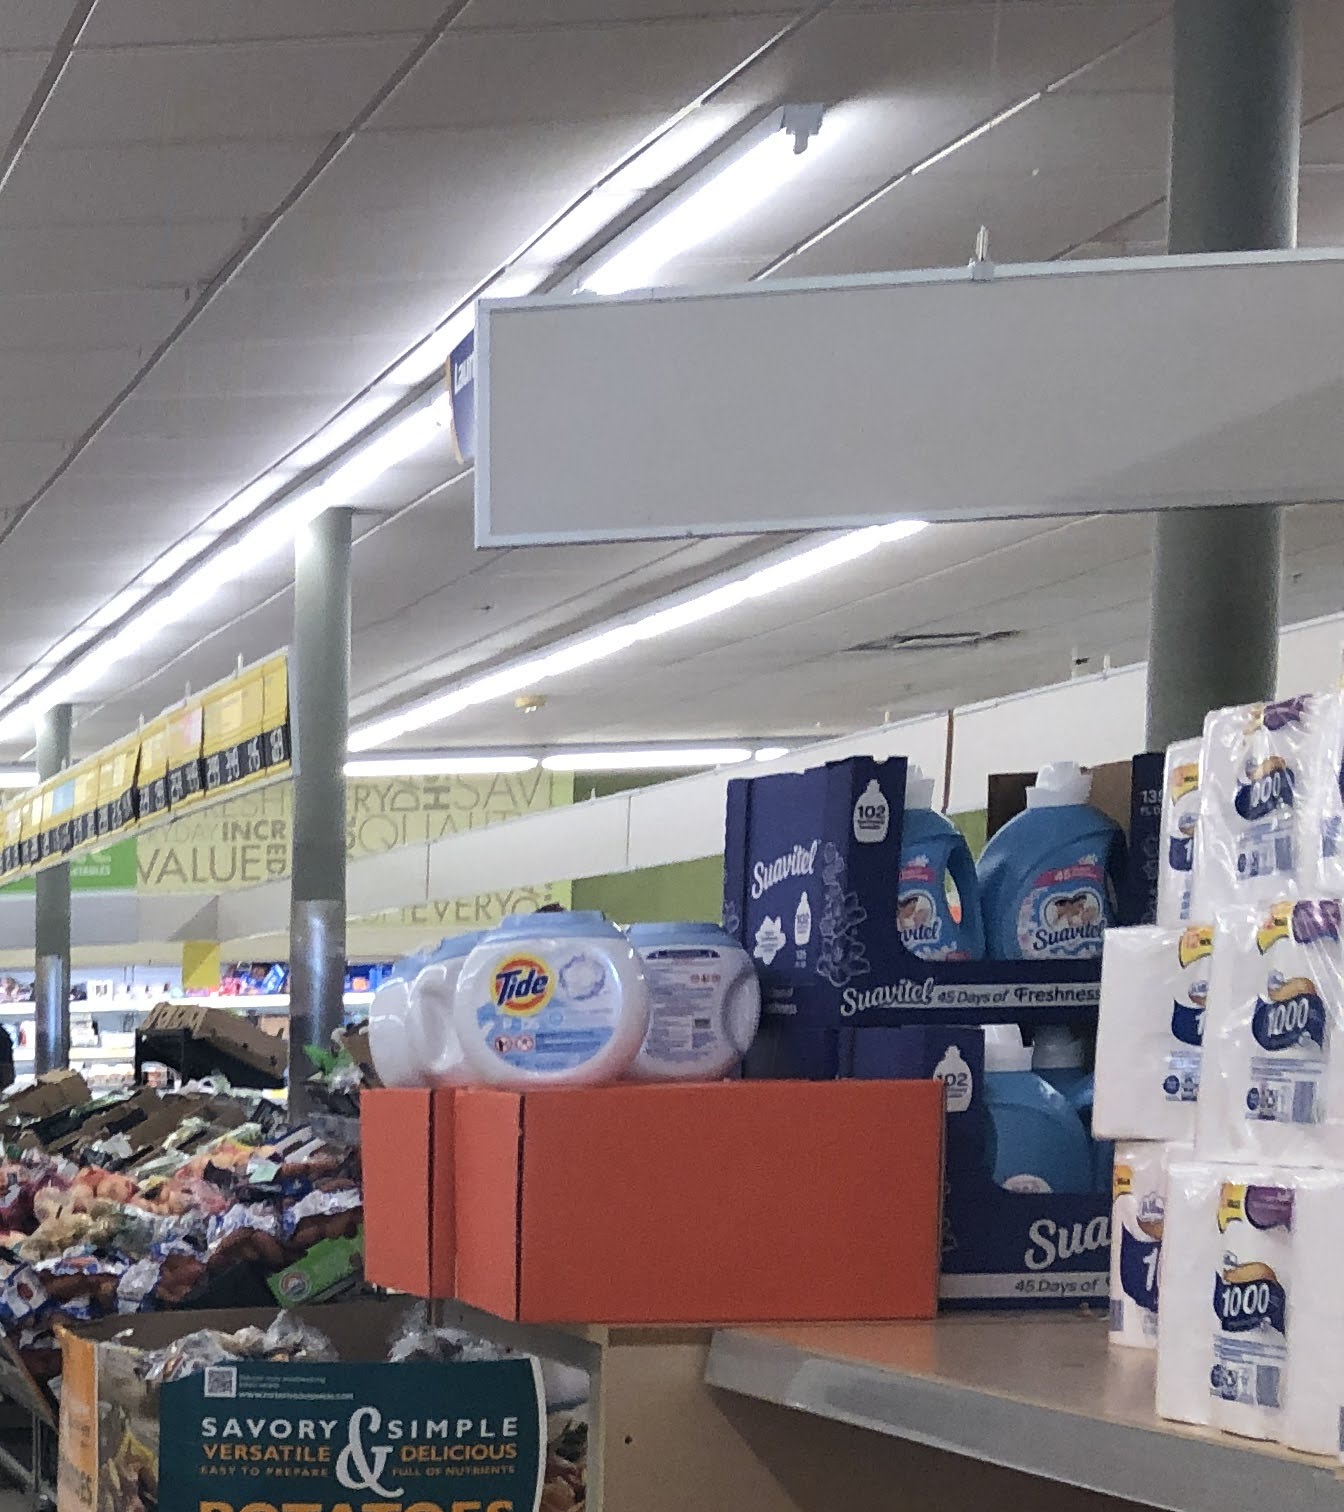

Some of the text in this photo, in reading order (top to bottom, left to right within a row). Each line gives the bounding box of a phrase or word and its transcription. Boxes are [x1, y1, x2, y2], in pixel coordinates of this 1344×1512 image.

[857, 804, 886, 819] 102
[222, 819, 287, 841] INCR
[137, 845, 262, 884] VALUE
[751, 839, 819, 899] Suavitel
[1033, 919, 1108, 950] Suavitel
[496, 969, 549, 1007] Tide
[841, 976, 935, 1017] Suavitel
[937, 985, 1101, 1006] 45 Days of Freshness
[1267, 997, 1309, 1038] 1000
[936, 1072, 968, 1087] 102
[1024, 1215, 1112, 1270] Sua
[1015, 1278, 1099, 1295] 45 Days of
[1222, 1282, 1270, 1318] 1000
[201, 1416, 338, 1440] SAVORY
[387, 1416, 519, 1440] SIMPLE
[202, 1442, 331, 1463] VERSATILE
[335, 1405, 405, 1499] &
[400, 1443, 517, 1463] DELICIOUS
[240, 1465, 260, 1477] TO
[266, 1466, 329, 1478] PREPARE
[445, 1465, 516, 1477] NUTRIENTS
